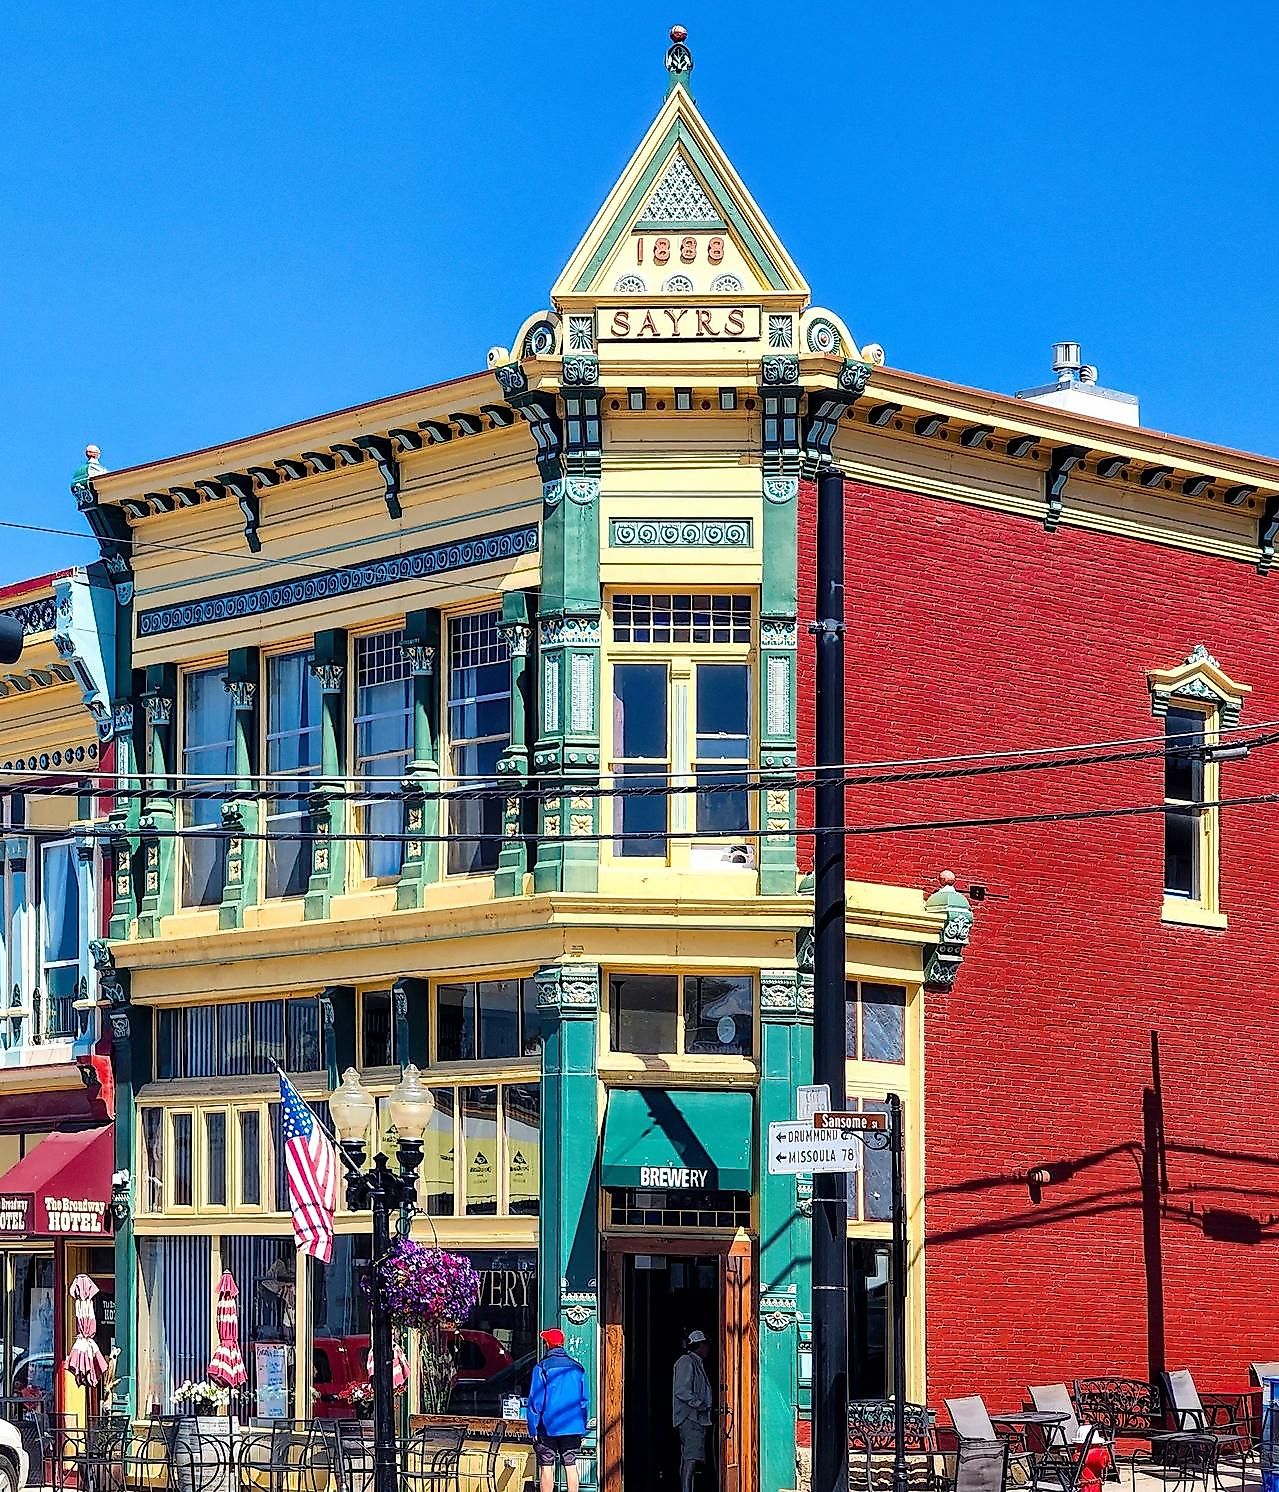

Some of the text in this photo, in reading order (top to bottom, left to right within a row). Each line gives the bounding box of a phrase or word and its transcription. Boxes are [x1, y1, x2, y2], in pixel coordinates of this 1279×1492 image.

[637, 237, 725, 263] 1888
[610, 309, 746, 337] SAYRS
[821, 1113, 868, 1129] Sansome
[788, 1130, 838, 1142] DRUMMOND
[788, 1148, 854, 1163] MISSOULA 78
[640, 1167, 708, 1188] BREWERY
[45, 1197, 106, 1215] The Broadway
[48, 1211, 102, 1232] HOTEL
